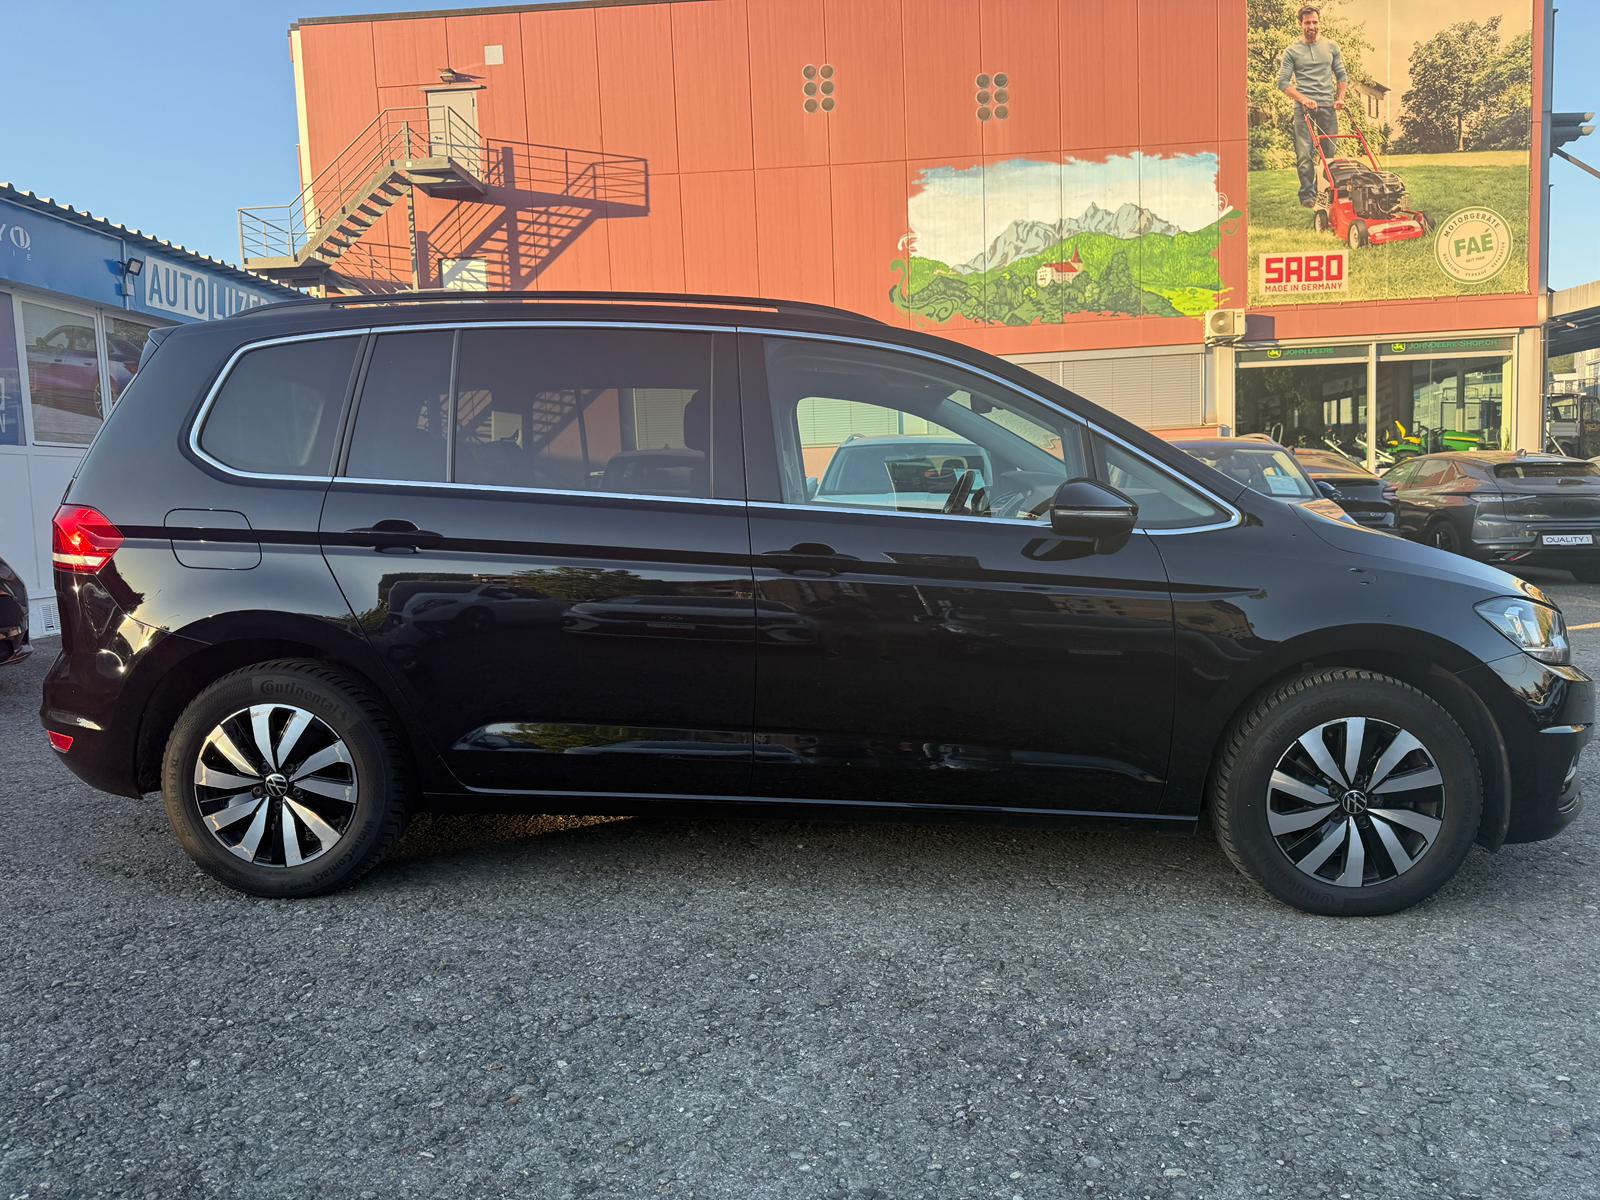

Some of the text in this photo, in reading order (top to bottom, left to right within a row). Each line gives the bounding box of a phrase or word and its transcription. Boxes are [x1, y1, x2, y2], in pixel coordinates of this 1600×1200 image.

[1444, 212, 1502, 238] MOTORGERÄTE
[1454, 227, 1494, 258] FAÉ
[1264, 254, 1343, 285] SABO
[149, 263, 206, 315] AUTO
[1264, 282, 1343, 293] MADE IN GERMANY
[260, 679, 340, 713] Continental
